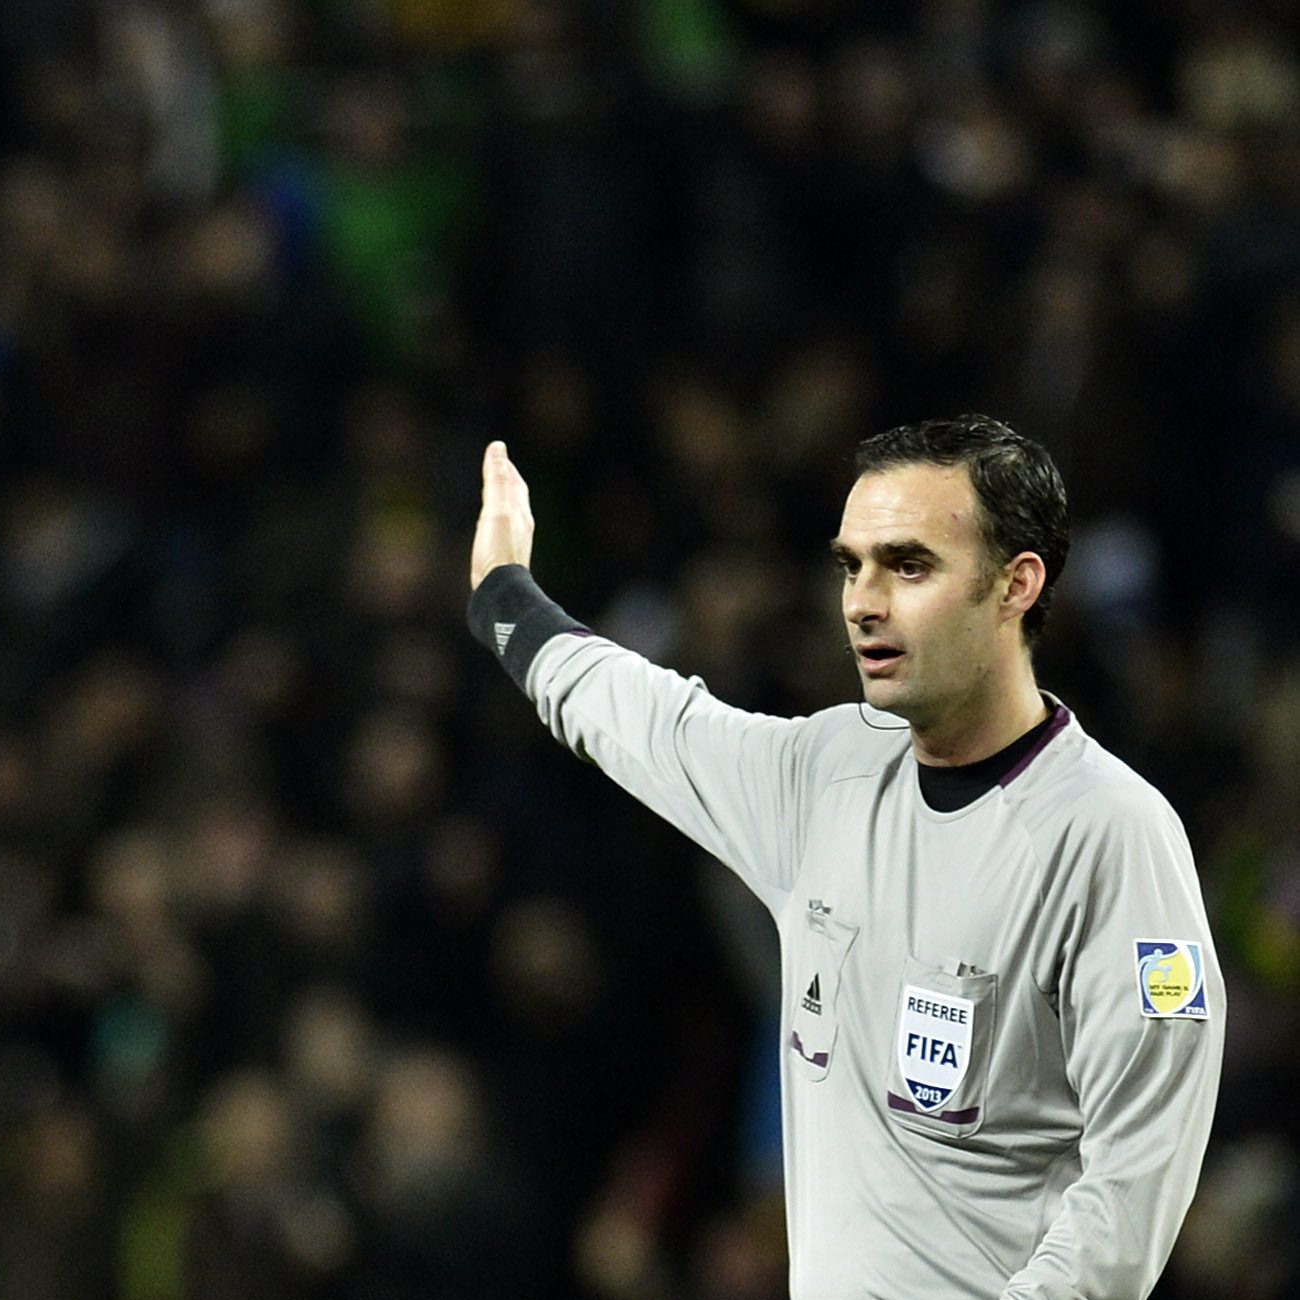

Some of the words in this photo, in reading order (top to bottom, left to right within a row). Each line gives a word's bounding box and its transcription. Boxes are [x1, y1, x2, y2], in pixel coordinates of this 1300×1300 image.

[908, 996, 968, 1025] REFEREE
[906, 1033, 958, 1069] FIFA
[914, 1085, 942, 1104] 2013
